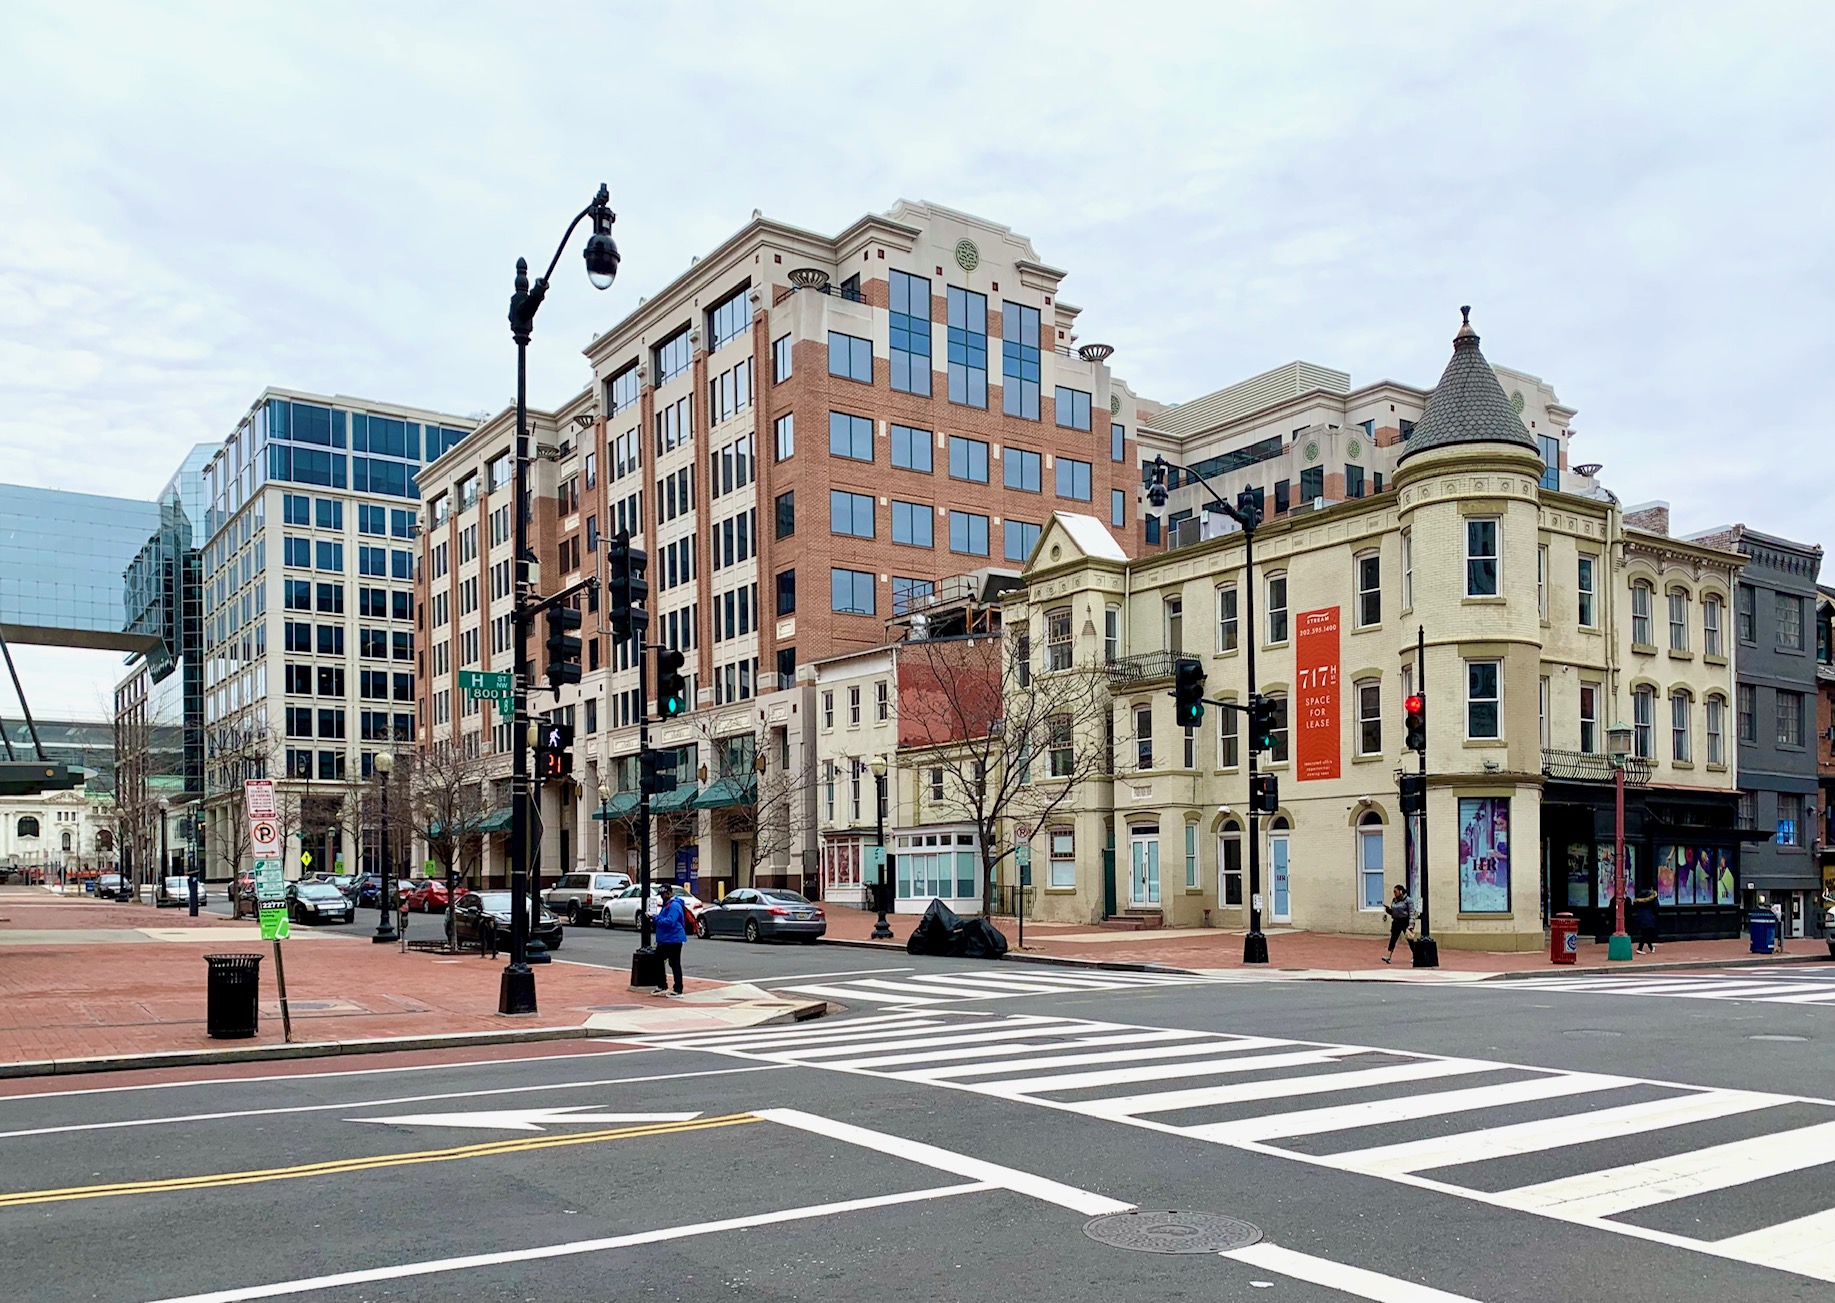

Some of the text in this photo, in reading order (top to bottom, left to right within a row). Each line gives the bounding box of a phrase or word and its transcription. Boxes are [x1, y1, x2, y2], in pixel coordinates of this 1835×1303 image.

[1307, 616, 1330, 624] STREAM
[1300, 624, 1336, 637] 202.595.1400
[471, 674, 484, 687] H
[1299, 665, 1336, 689] 717 H
[474, 689, 498, 698] 800
[504, 700, 508, 712] 8
[1305, 695, 1330, 706] SPACE
[1310, 707, 1326, 717] FOR
[1306, 718, 1330, 729] LEASE
